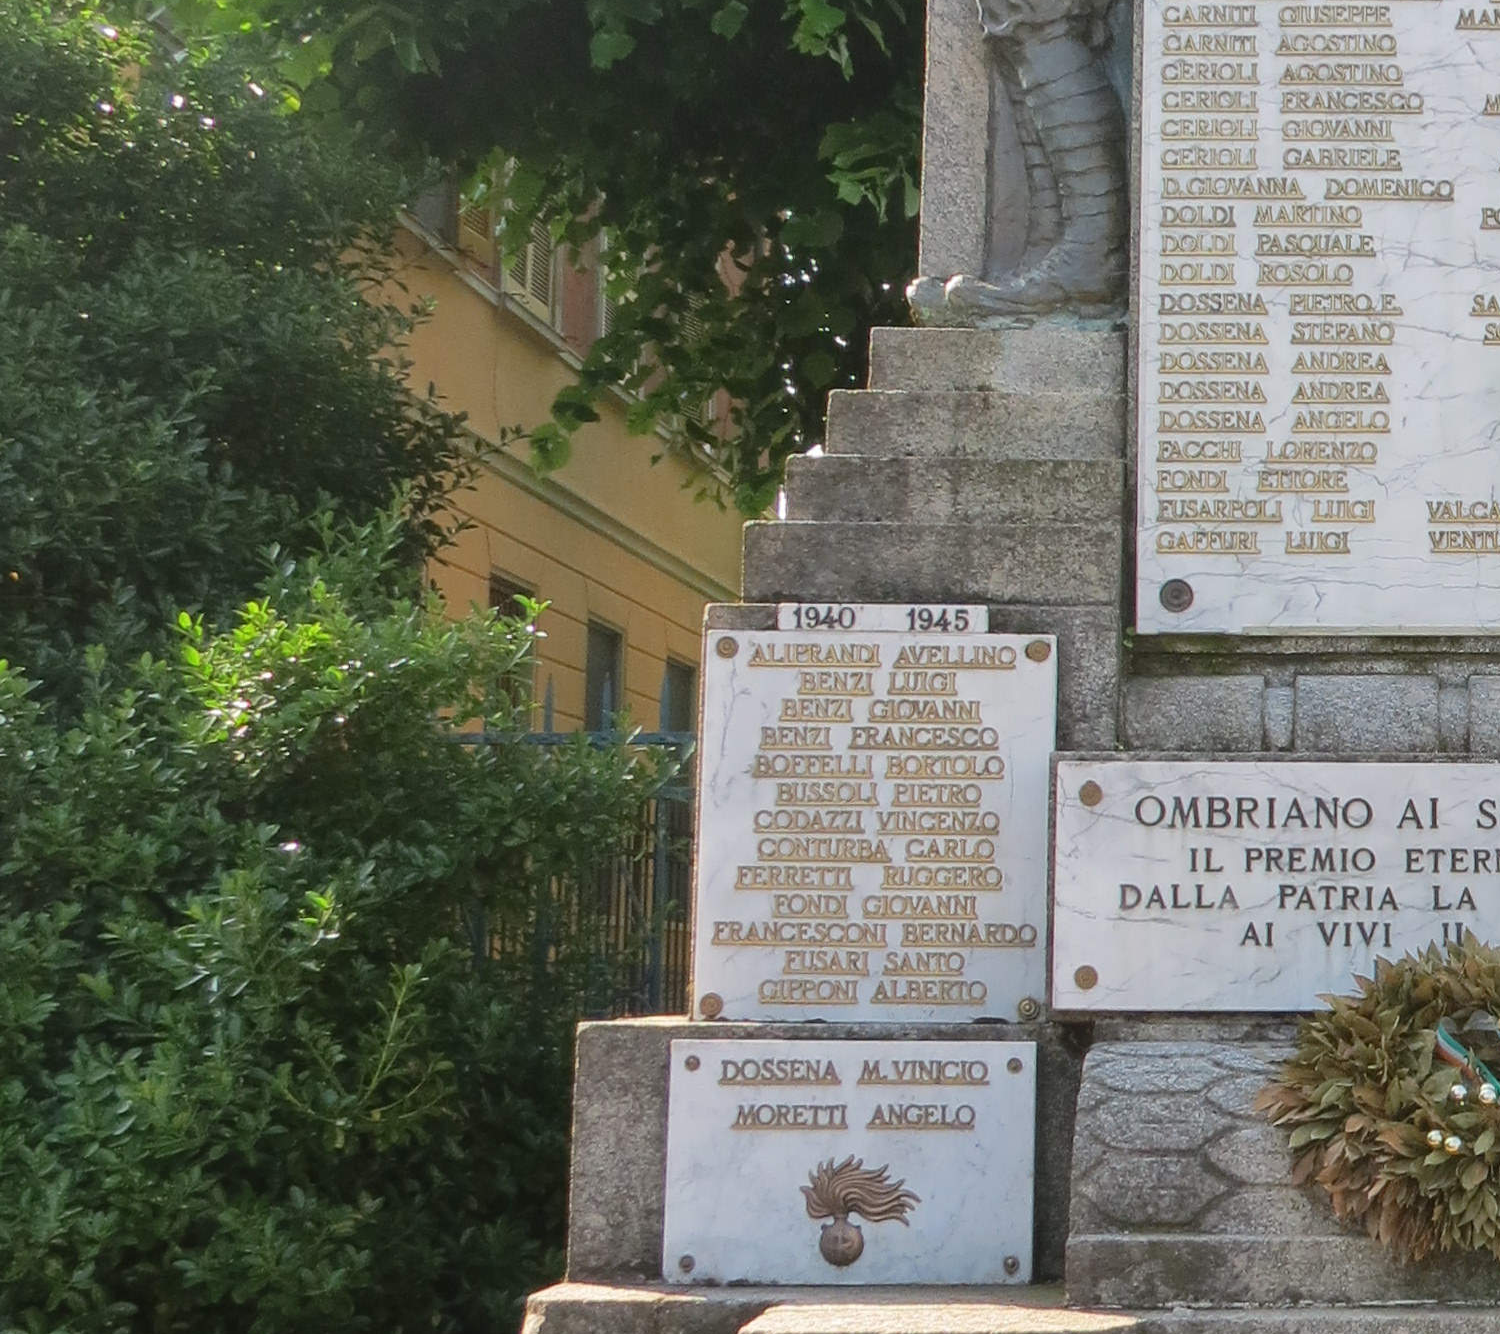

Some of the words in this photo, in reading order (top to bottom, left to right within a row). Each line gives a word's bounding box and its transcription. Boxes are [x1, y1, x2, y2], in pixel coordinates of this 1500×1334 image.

[1162, 91, 1258, 112] CERIOLI
[1280, 92, 1424, 114] FRANCESCO
[1160, 234, 1237, 256] DOLDI
[1255, 234, 1376, 258] PASQUALE
[1158, 323, 1269, 344] DOSSENA
[1291, 323, 1394, 345] STEFANO
[1157, 441, 1241, 462] FACCHI
[1263, 441, 1378, 463] LORENZO
[793, 608, 856, 629] 1940
[906, 608, 969, 631] 1945
[749, 643, 881, 667] ALIPRANDI
[893, 645, 1017, 668] AVELLINO
[798, 672, 873, 695] BENZI
[888, 672, 958, 695] LUIGI
[779, 699, 852, 722] BENZI
[868, 700, 982, 723] GIOVANNI
[759, 727, 832, 750] BENZI
[849, 727, 999, 750] FRANCESCO
[752, 755, 873, 778] BOFFELLI
[885, 756, 1004, 779] BORTOLO
[776, 783, 878, 806] BUSSOLI
[891, 784, 982, 807] PIETRO
[754, 811, 865, 833] CODAZZI
[877, 812, 1000, 835] VINCENZO
[1135, 795, 1373, 829] OMBRIANO
[1397, 798, 1439, 829] AI
[1190, 848, 1223, 872] IL
[1245, 848, 1376, 873] PREMIO
[735, 866, 854, 890] FERRETTI
[881, 867, 1002, 890] RUGGERO
[772, 894, 848, 918] FONDI
[862, 895, 978, 919] GIOVANNI
[1119, 884, 1240, 910] DALLA
[1279, 884, 1398, 910] PATRIA
[1433, 885, 1476, 910] LA
[711, 921, 888, 946] FRANCESCONI
[901, 924, 1037, 947] BERNARDO
[1240, 923, 1273, 946] AI
[1317, 923, 1391, 947] VIVI
[783, 950, 870, 975] FUSARI
[882, 952, 965, 976] SANTO
[758, 980, 858, 1004] GIPPONI
[870, 981, 987, 1004] ALBERTO
[719, 1059, 841, 1085] DOSSENA
[731, 1104, 848, 1129] MORETTI
[866, 1105, 975, 1130] ANGELO
